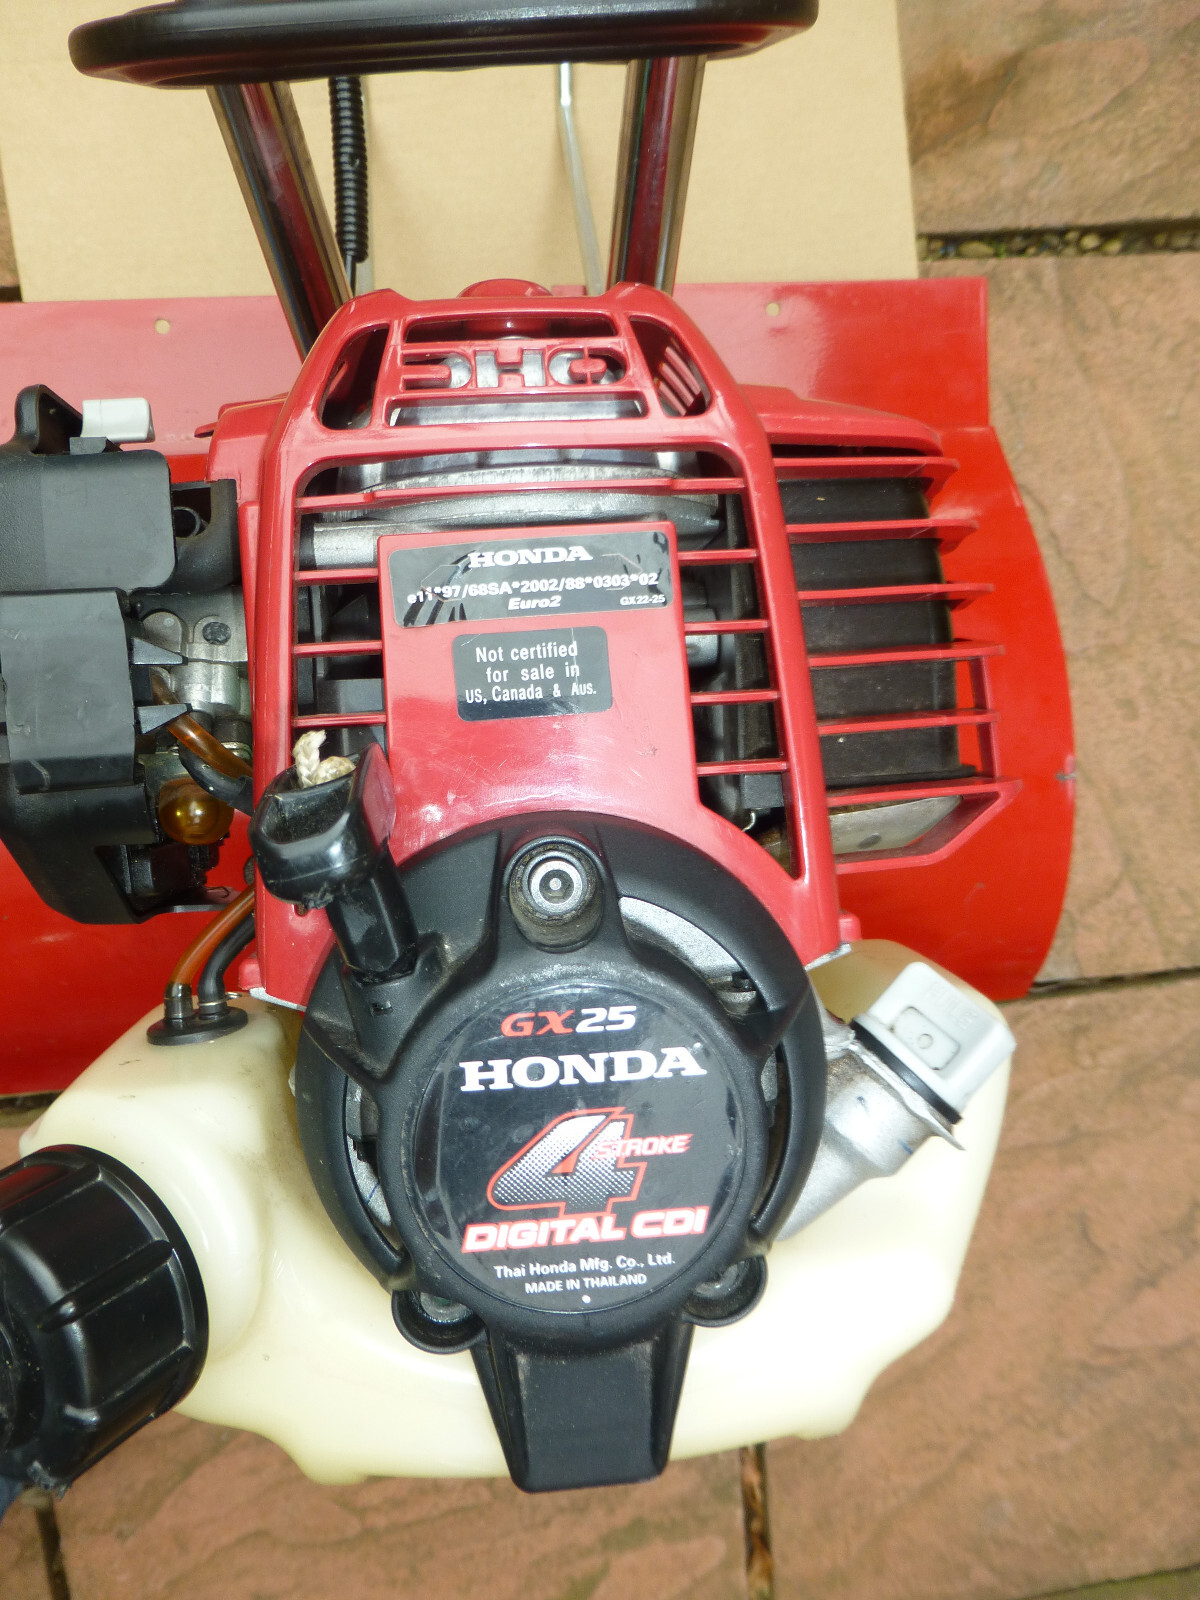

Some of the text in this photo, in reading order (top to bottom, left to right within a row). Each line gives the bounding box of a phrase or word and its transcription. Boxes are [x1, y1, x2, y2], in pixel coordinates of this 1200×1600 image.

[467, 545, 594, 568] HONDA
[508, 595, 562, 611] Euro2
[620, 594, 666, 606] GX22-25
[475, 640, 578, 663] Not certified
[486, 661, 580, 683] for sale in
[465, 682, 597, 704] US, Canada & Aus.
[459, 1046, 707, 1092] HONDA
[596, 1134, 692, 1160] STROKE
[487, 1106, 647, 1217] 4
[462, 1205, 710, 1253] DIGITAL CDI
[493, 1251, 676, 1279] Thai Honda Mfg. Co., Ltd.
[525, 1273, 648, 1294] MADE IN THAILAND
